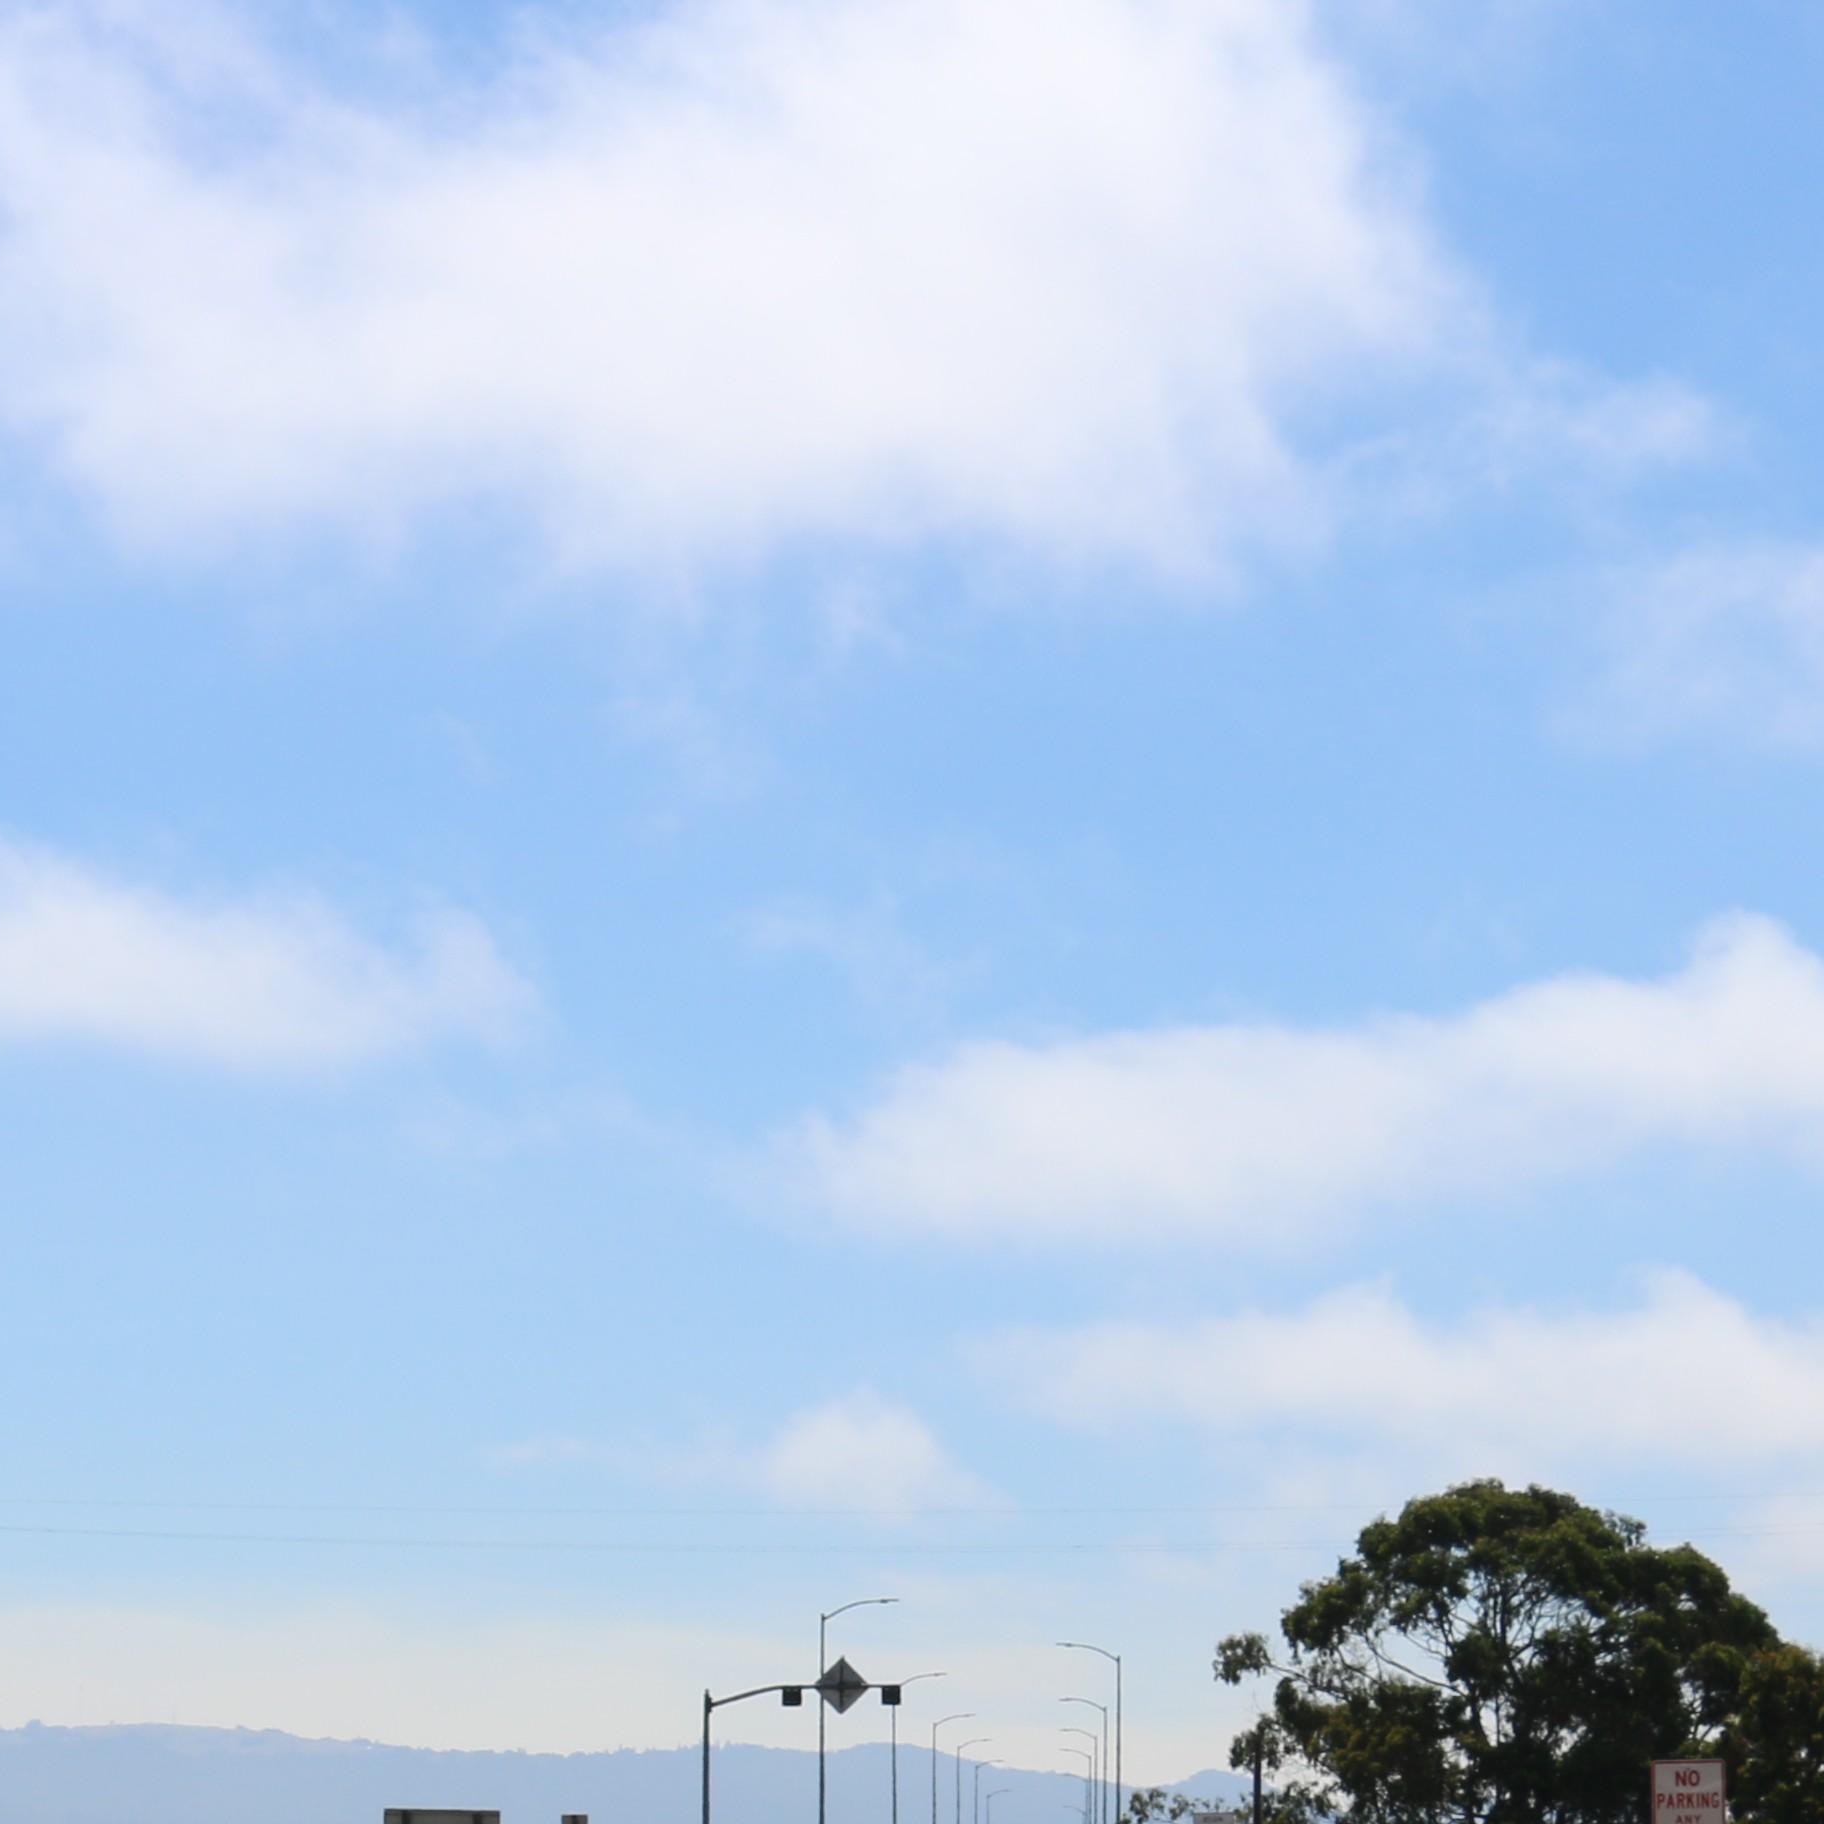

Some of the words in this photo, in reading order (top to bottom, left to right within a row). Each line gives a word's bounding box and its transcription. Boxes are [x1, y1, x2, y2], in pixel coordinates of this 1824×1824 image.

[1675, 1770, 1701, 1786] NO
[1657, 1792, 1720, 1809] PARKING
[1676, 1814, 1702, 1824] ANY
